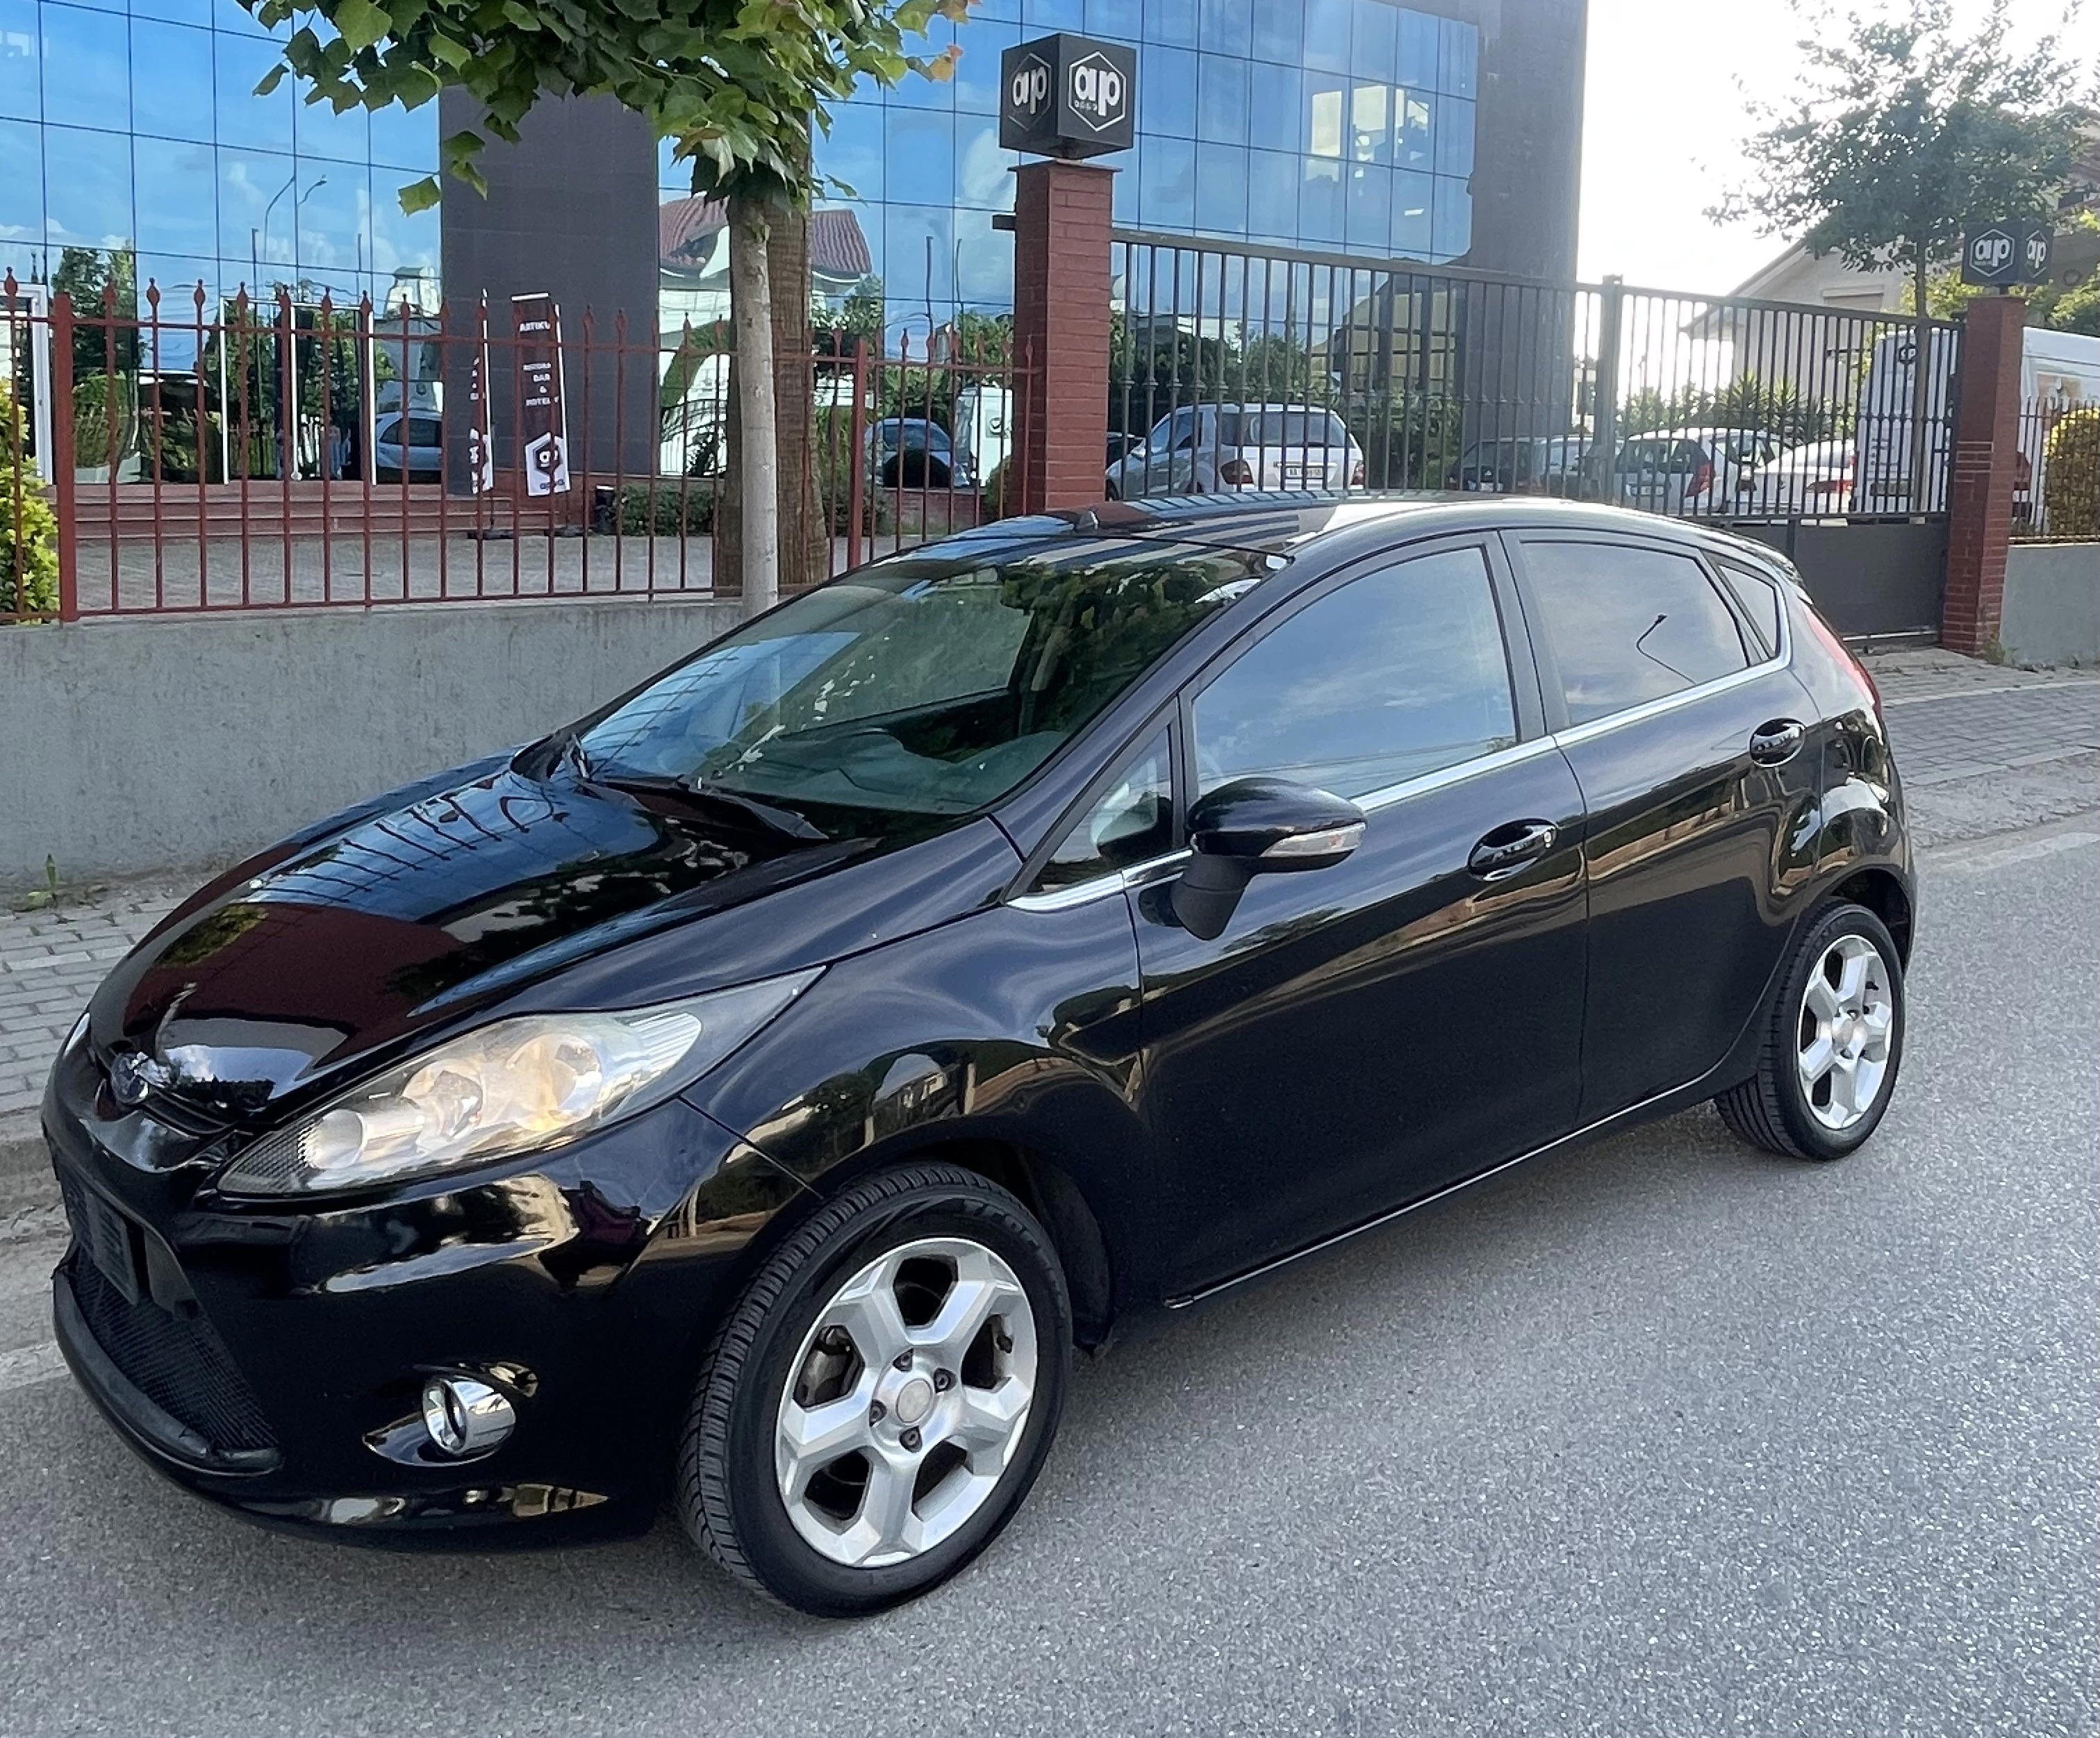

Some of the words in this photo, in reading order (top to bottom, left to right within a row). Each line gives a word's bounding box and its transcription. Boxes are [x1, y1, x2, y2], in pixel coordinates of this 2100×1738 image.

[1013, 66, 1048, 115] ap
[1074, 66, 1121, 117] ap
[1975, 238, 2010, 267] ap
[2027, 240, 2047, 269] ap
